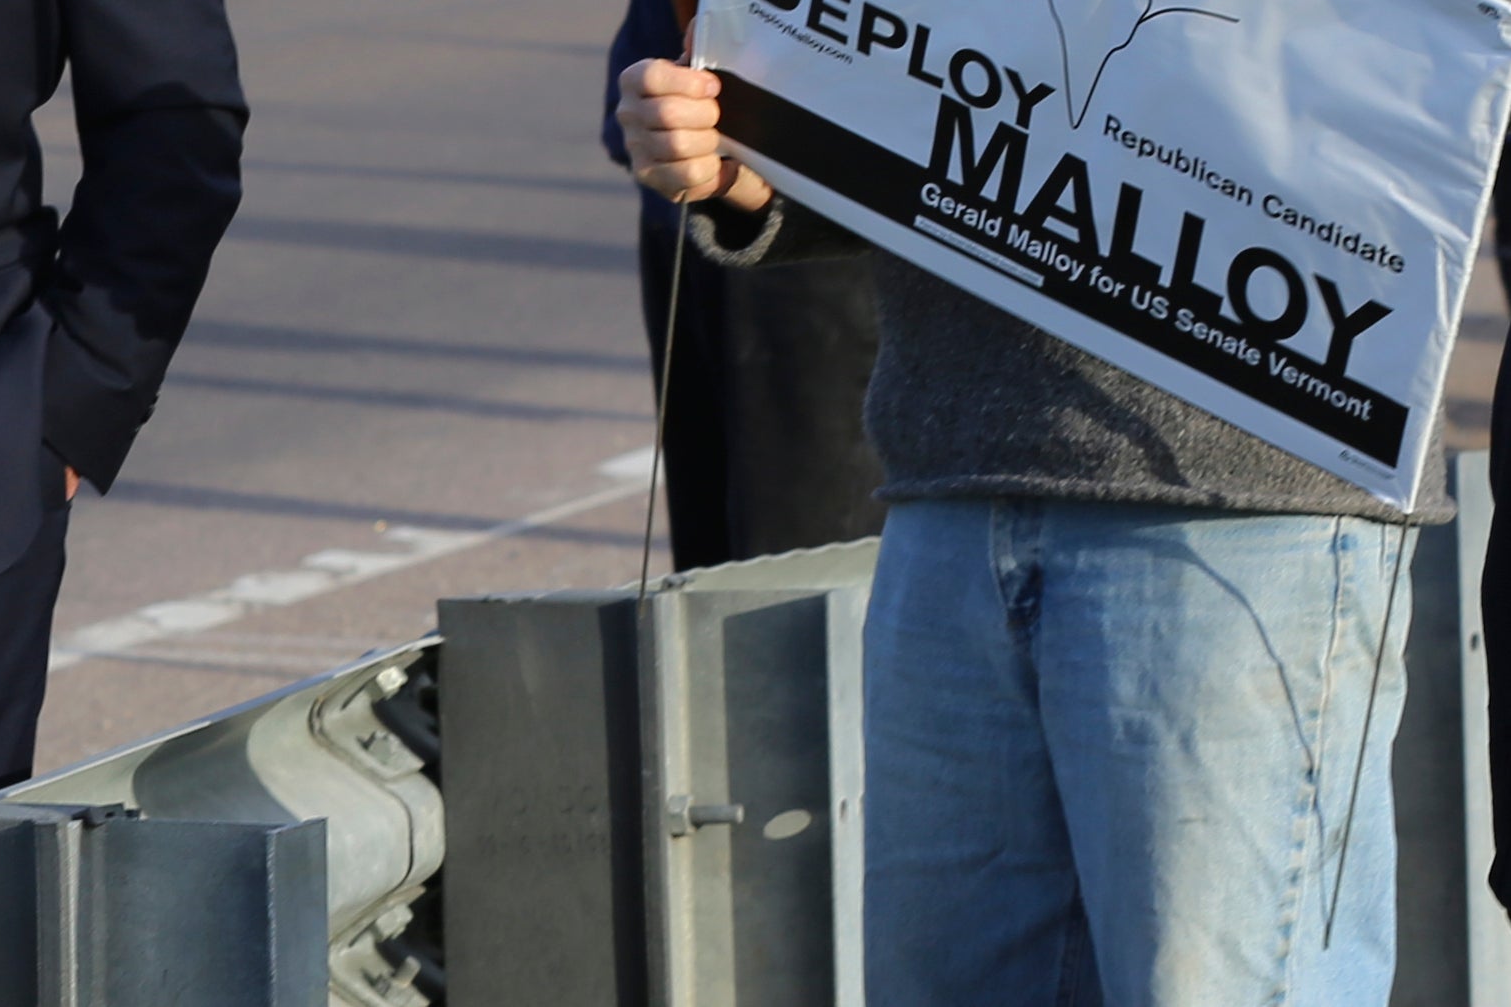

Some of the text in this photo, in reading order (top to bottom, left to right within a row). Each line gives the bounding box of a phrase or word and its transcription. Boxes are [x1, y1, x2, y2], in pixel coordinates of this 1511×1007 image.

[920, 183, 1373, 421] Gerald Malloy for US Senate Vermont
[927, 94, 1394, 377] MALLOY
[1103, 114, 1405, 273] Republican Candidate
